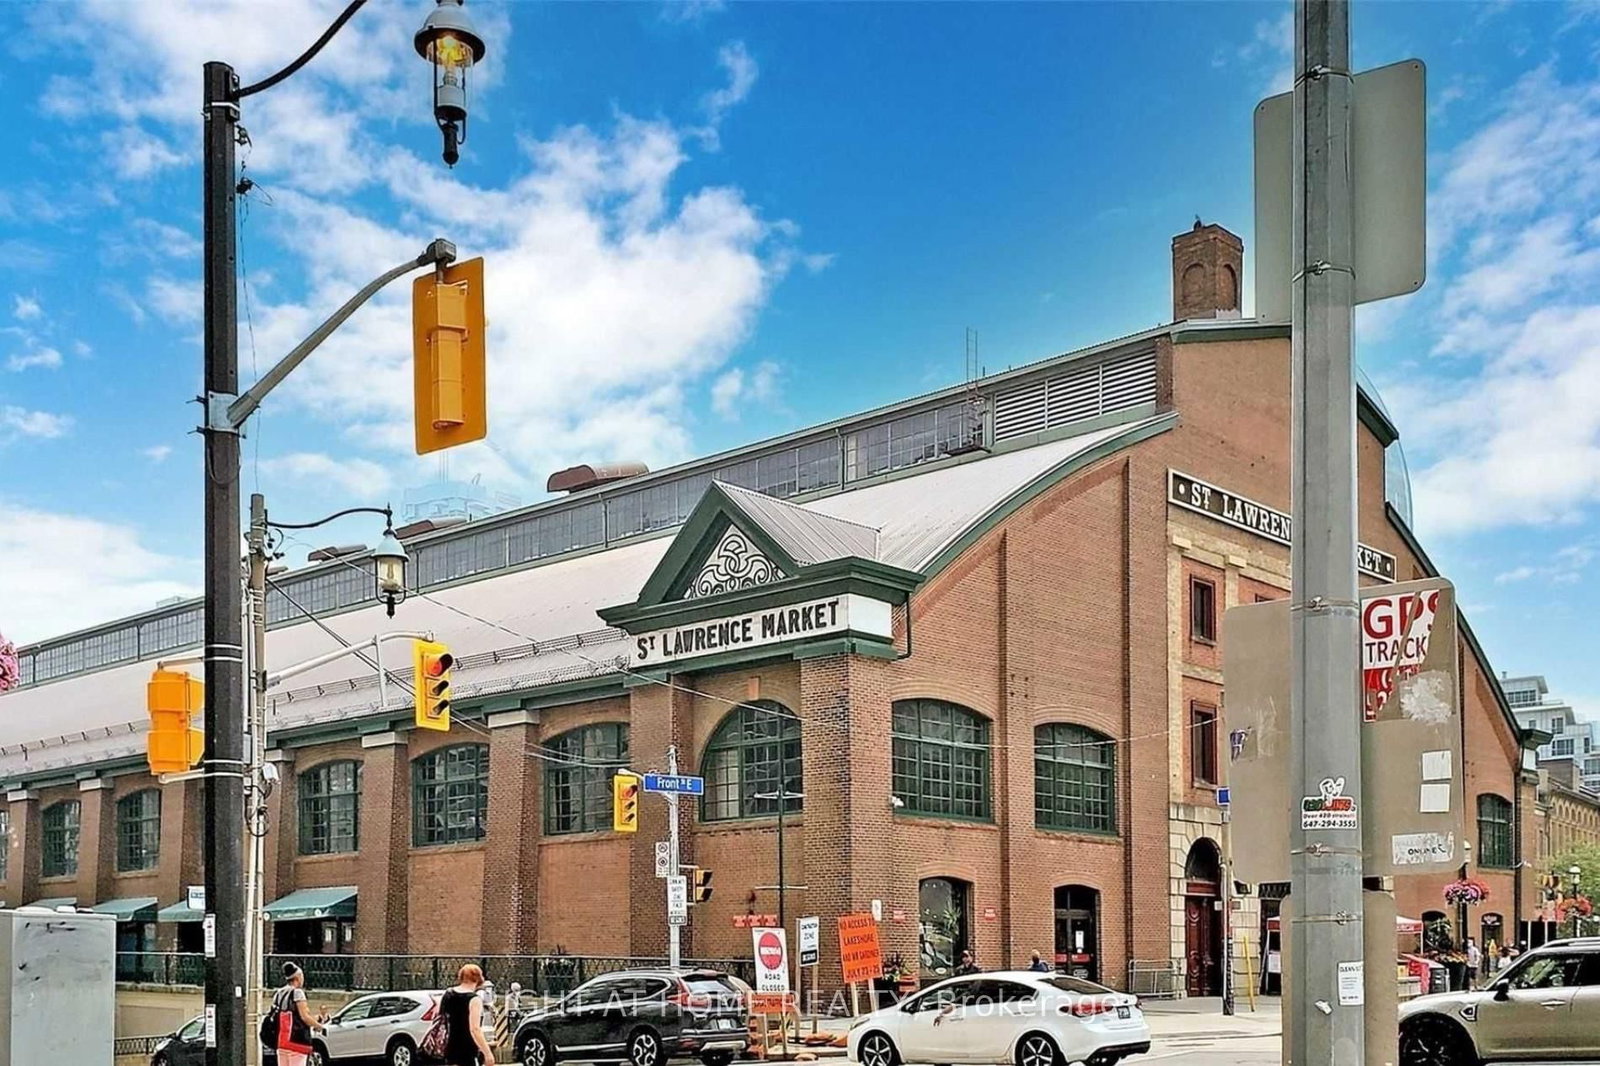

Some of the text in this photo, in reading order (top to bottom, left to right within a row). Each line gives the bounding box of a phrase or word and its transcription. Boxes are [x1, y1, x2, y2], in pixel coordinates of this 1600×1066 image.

[662, 617, 753, 656] LAWRENCE
[761, 599, 840, 639] MARKET
[657, 776, 680, 790] Front
[686, 778, 693, 790] E
